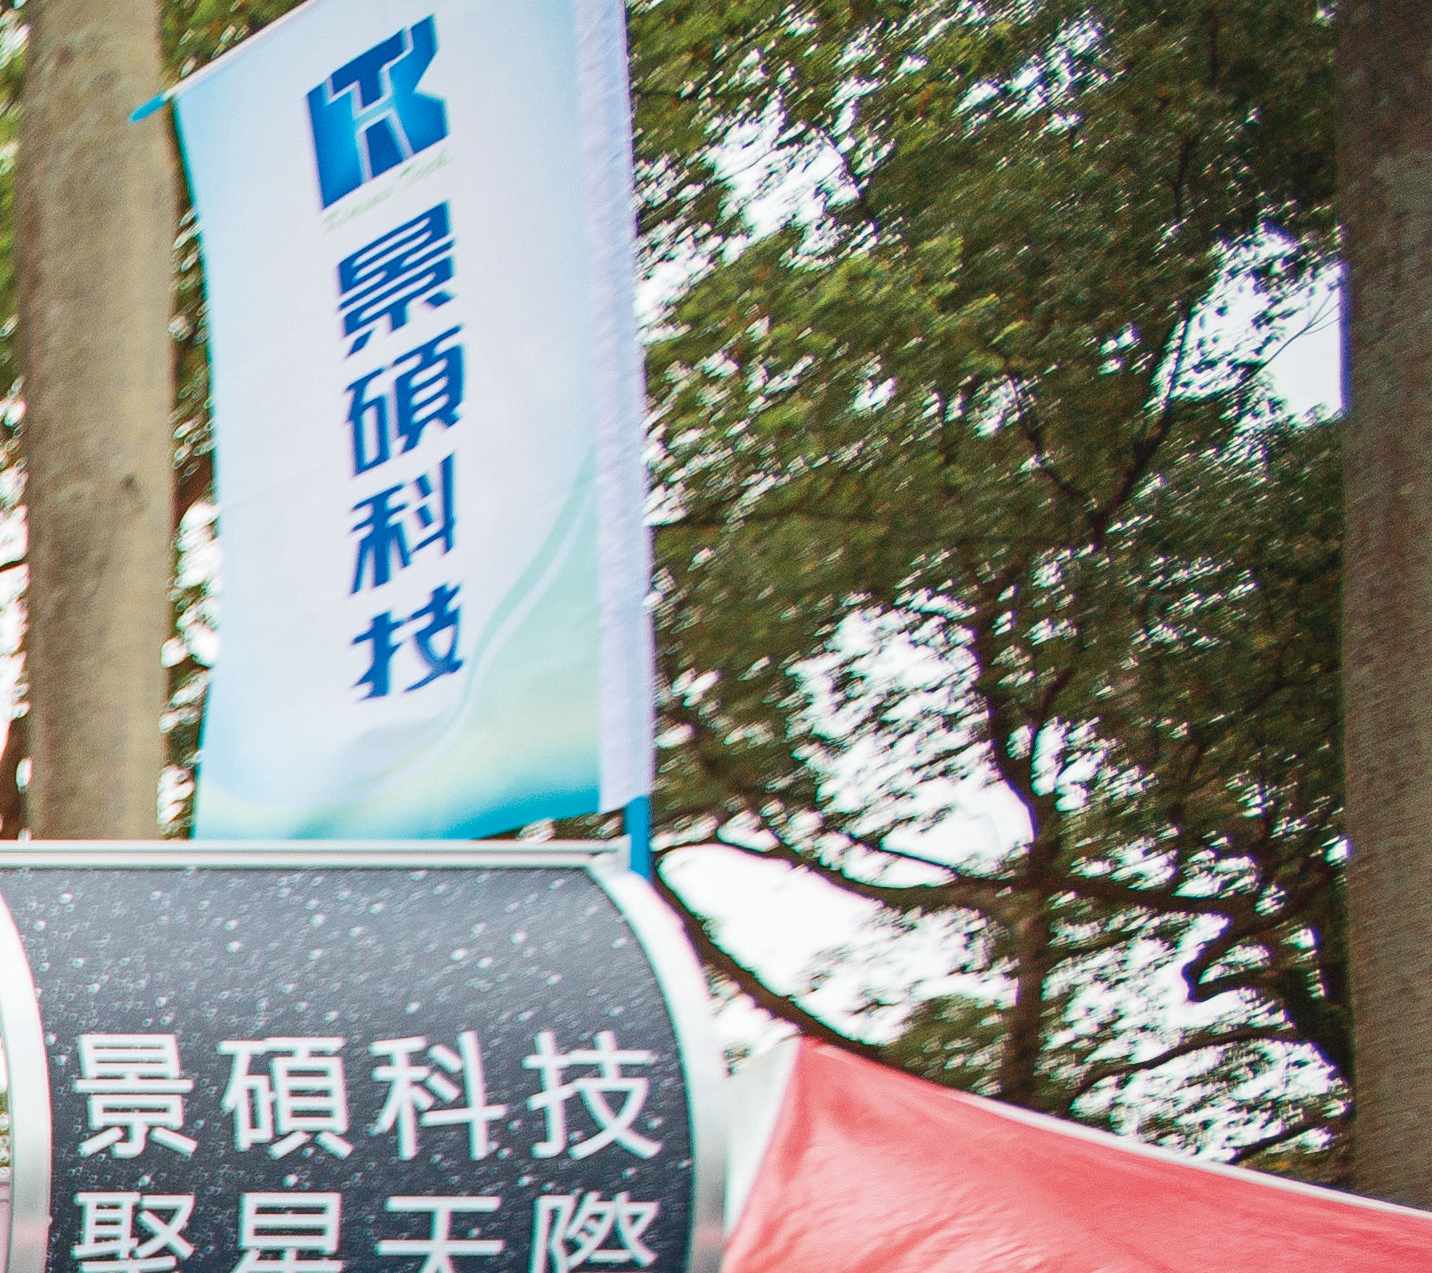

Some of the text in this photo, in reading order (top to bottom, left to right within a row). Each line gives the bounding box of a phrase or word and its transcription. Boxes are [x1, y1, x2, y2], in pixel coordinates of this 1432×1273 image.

[337, 201, 466, 702] 景碩科技
[72, 1029, 664, 1161] 景碩科技
